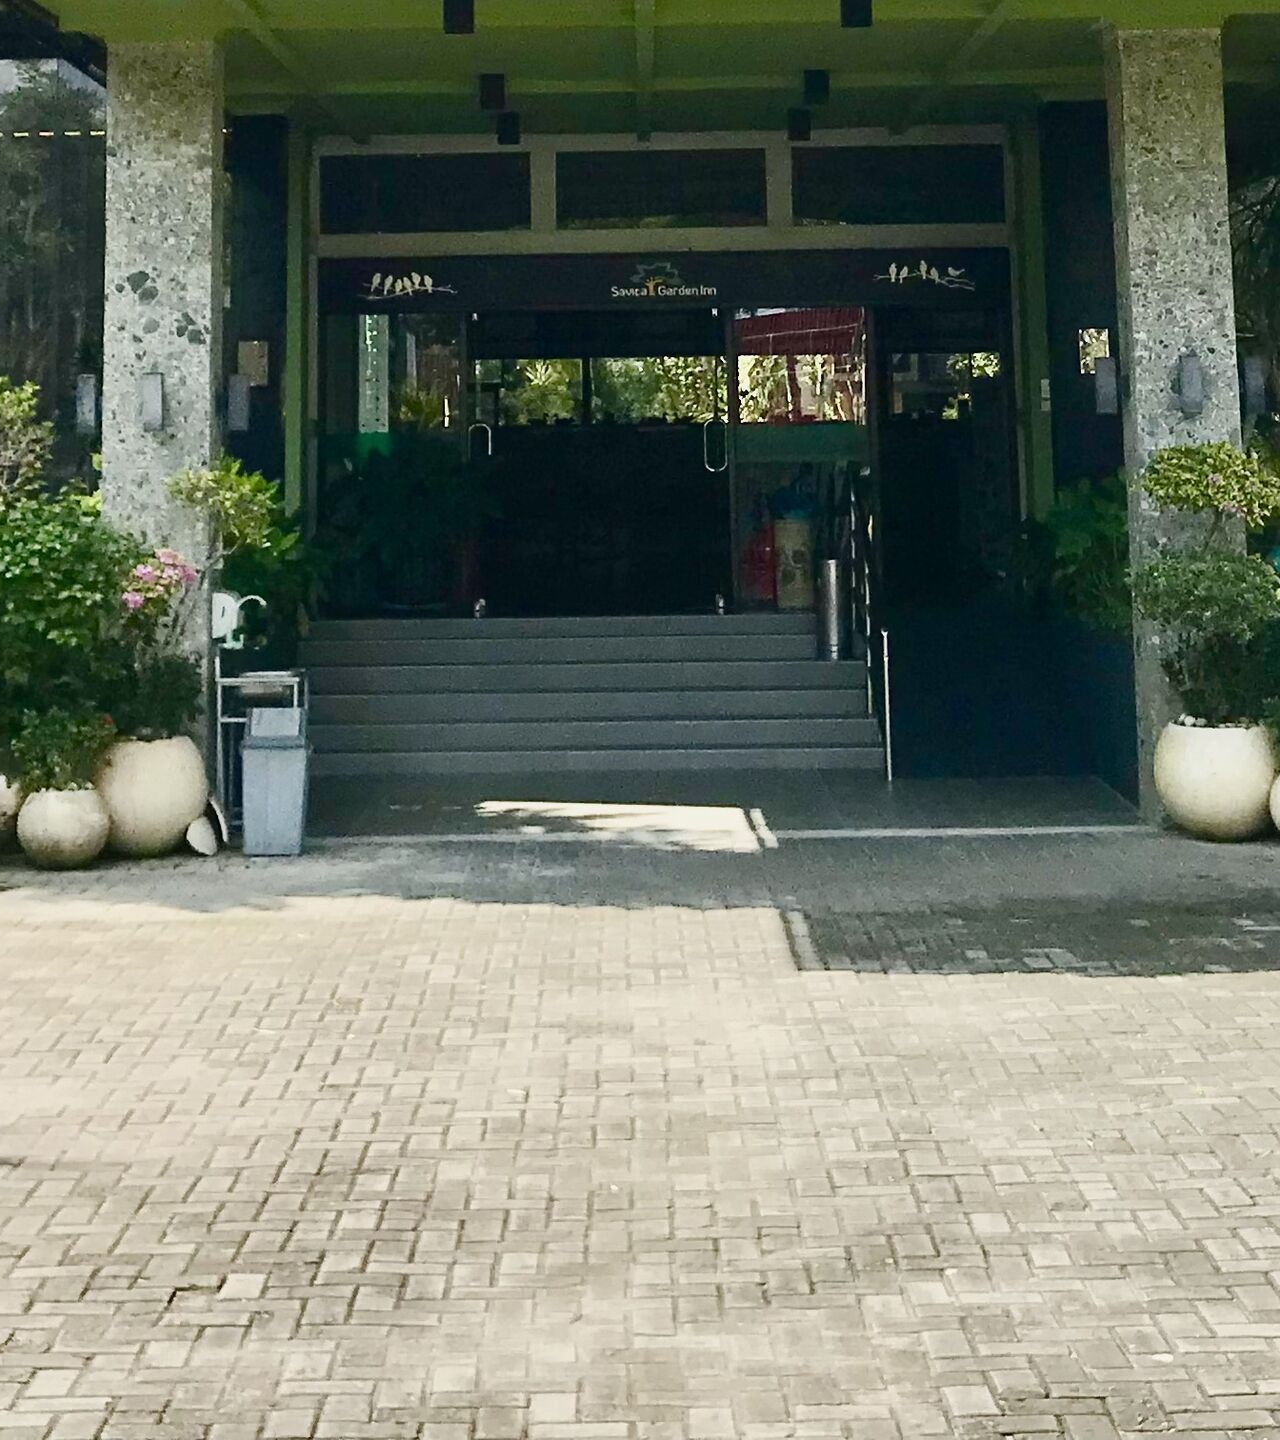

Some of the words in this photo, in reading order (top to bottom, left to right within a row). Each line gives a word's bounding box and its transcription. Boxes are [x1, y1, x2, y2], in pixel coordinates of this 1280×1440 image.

[610, 285, 648, 297] Savita
[657, 285, 699, 296] Garden
[700, 284, 717, 296] Inn
